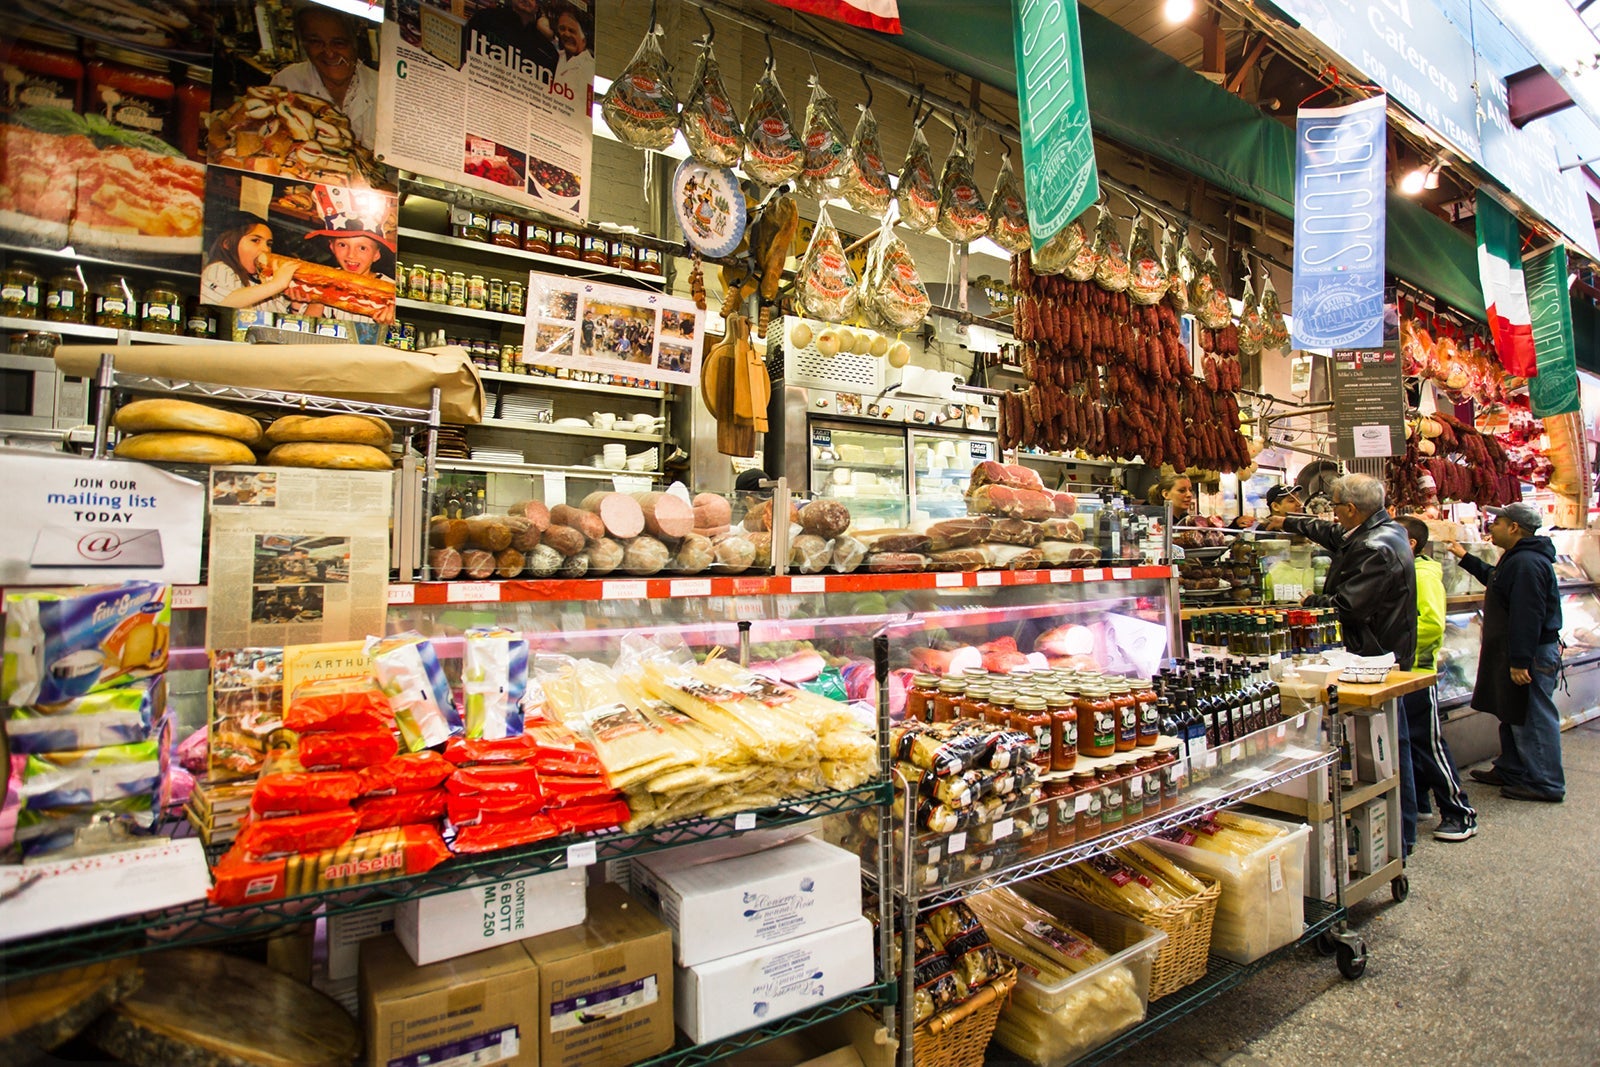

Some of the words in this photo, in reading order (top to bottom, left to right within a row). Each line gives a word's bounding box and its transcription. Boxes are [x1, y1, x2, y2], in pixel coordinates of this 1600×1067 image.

[471, 28, 554, 86] Italian
[1368, 5, 1459, 103] Caterers
[548, 75, 575, 101] job
[1026, 32, 1071, 142] DELI
[1362, 49, 1389, 84] FOR
[1391, 73, 1423, 110] OVER
[1441, 113, 1478, 153] YEARS
[1034, 219, 1060, 236] LITTLE
[1076, 167, 1090, 193] NYC
[1301, 118, 1375, 265] GRECO'S
[1525, 250, 1561, 321] MIKE'S
[1300, 333, 1331, 346] LITTLE
[1359, 320, 1376, 336] NYC
[47, 492, 122, 509] mailing
[128, 494, 157, 508] list
[74, 478, 103, 488] JOIN
[109, 480, 137, 490] OUR
[74, 511, 133, 523] TODAY
[325, 849, 403, 879] anisetti
[485, 886, 497, 909] ML
[501, 883, 511, 891] 6
[500, 895, 512, 932] BOTT
[515, 879, 526, 931] CONTIENE
[484, 912, 496, 937] 250
